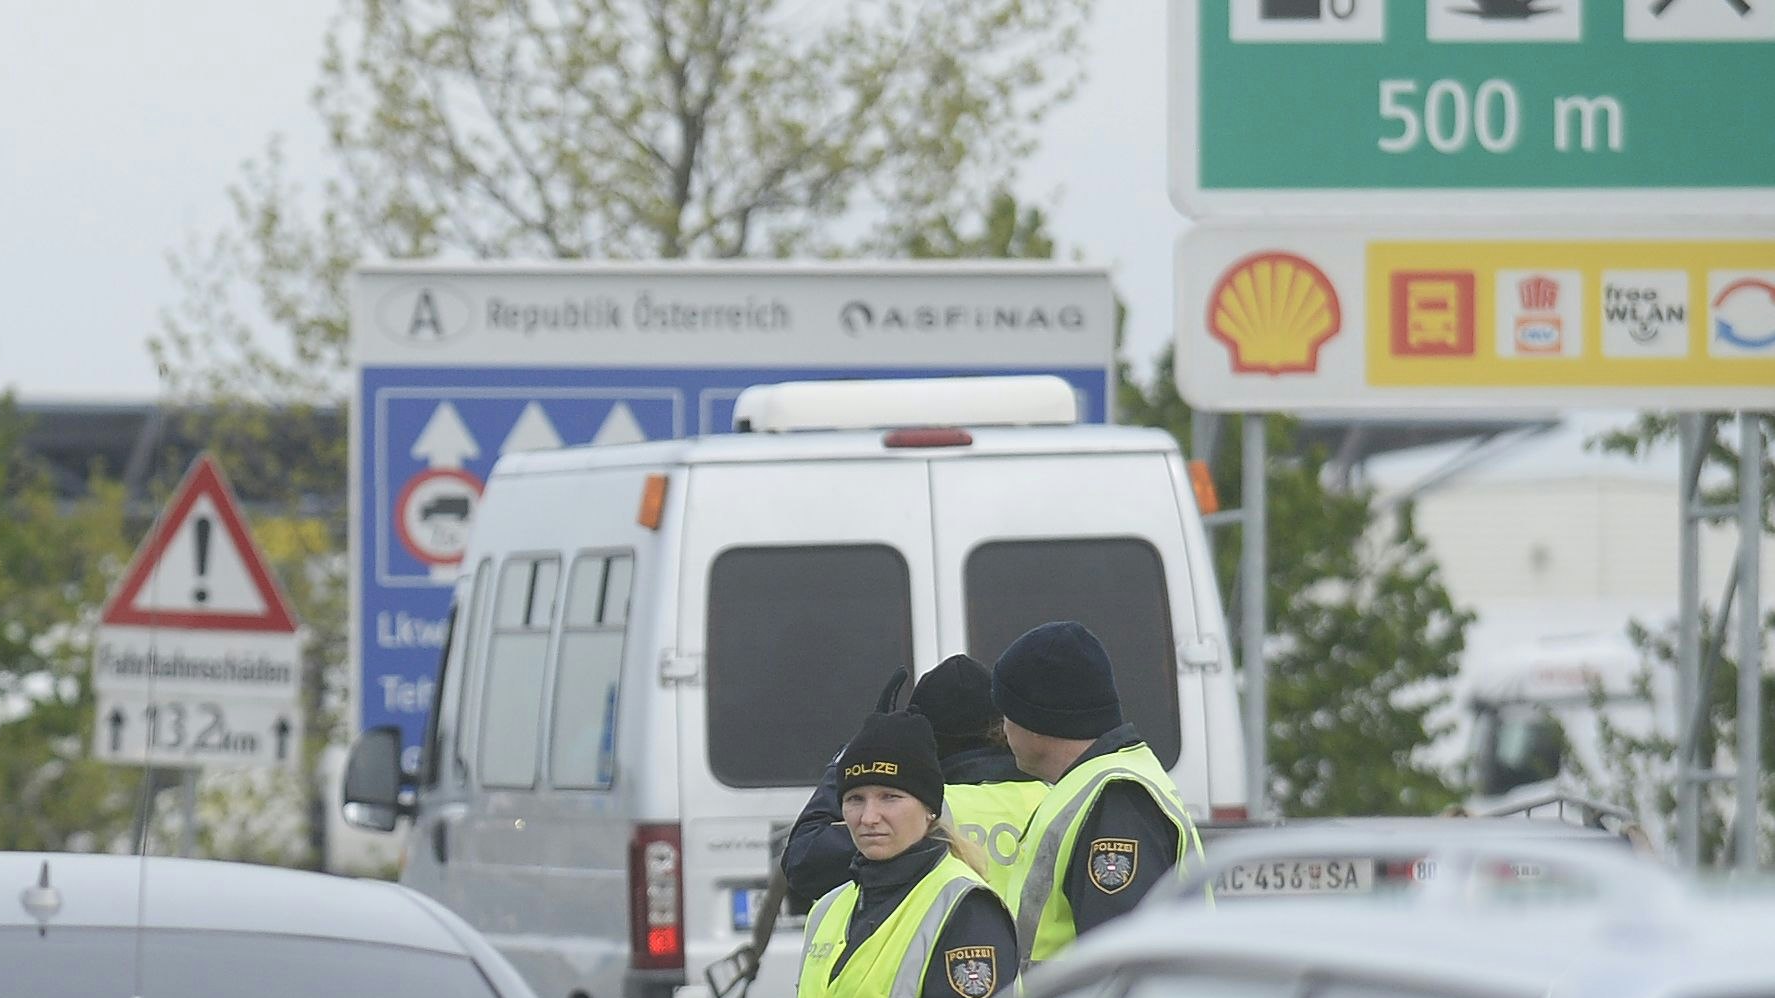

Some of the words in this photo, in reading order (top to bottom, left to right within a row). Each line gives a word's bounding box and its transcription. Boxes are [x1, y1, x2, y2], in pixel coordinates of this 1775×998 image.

[1377, 79, 1520, 153] 500
[1553, 96, 1624, 152] m
[408, 288, 444, 337] A
[485, 296, 623, 337] Republik
[632, 289, 791, 332] Österreich
[1605, 304, 1684, 321] WLAN
[845, 761, 897, 780] POLIZEI
[1094, 842, 1133, 853] POLIZEI
[1327, 862, 1358, 888] SA
[949, 949, 991, 961] POLIZEI
